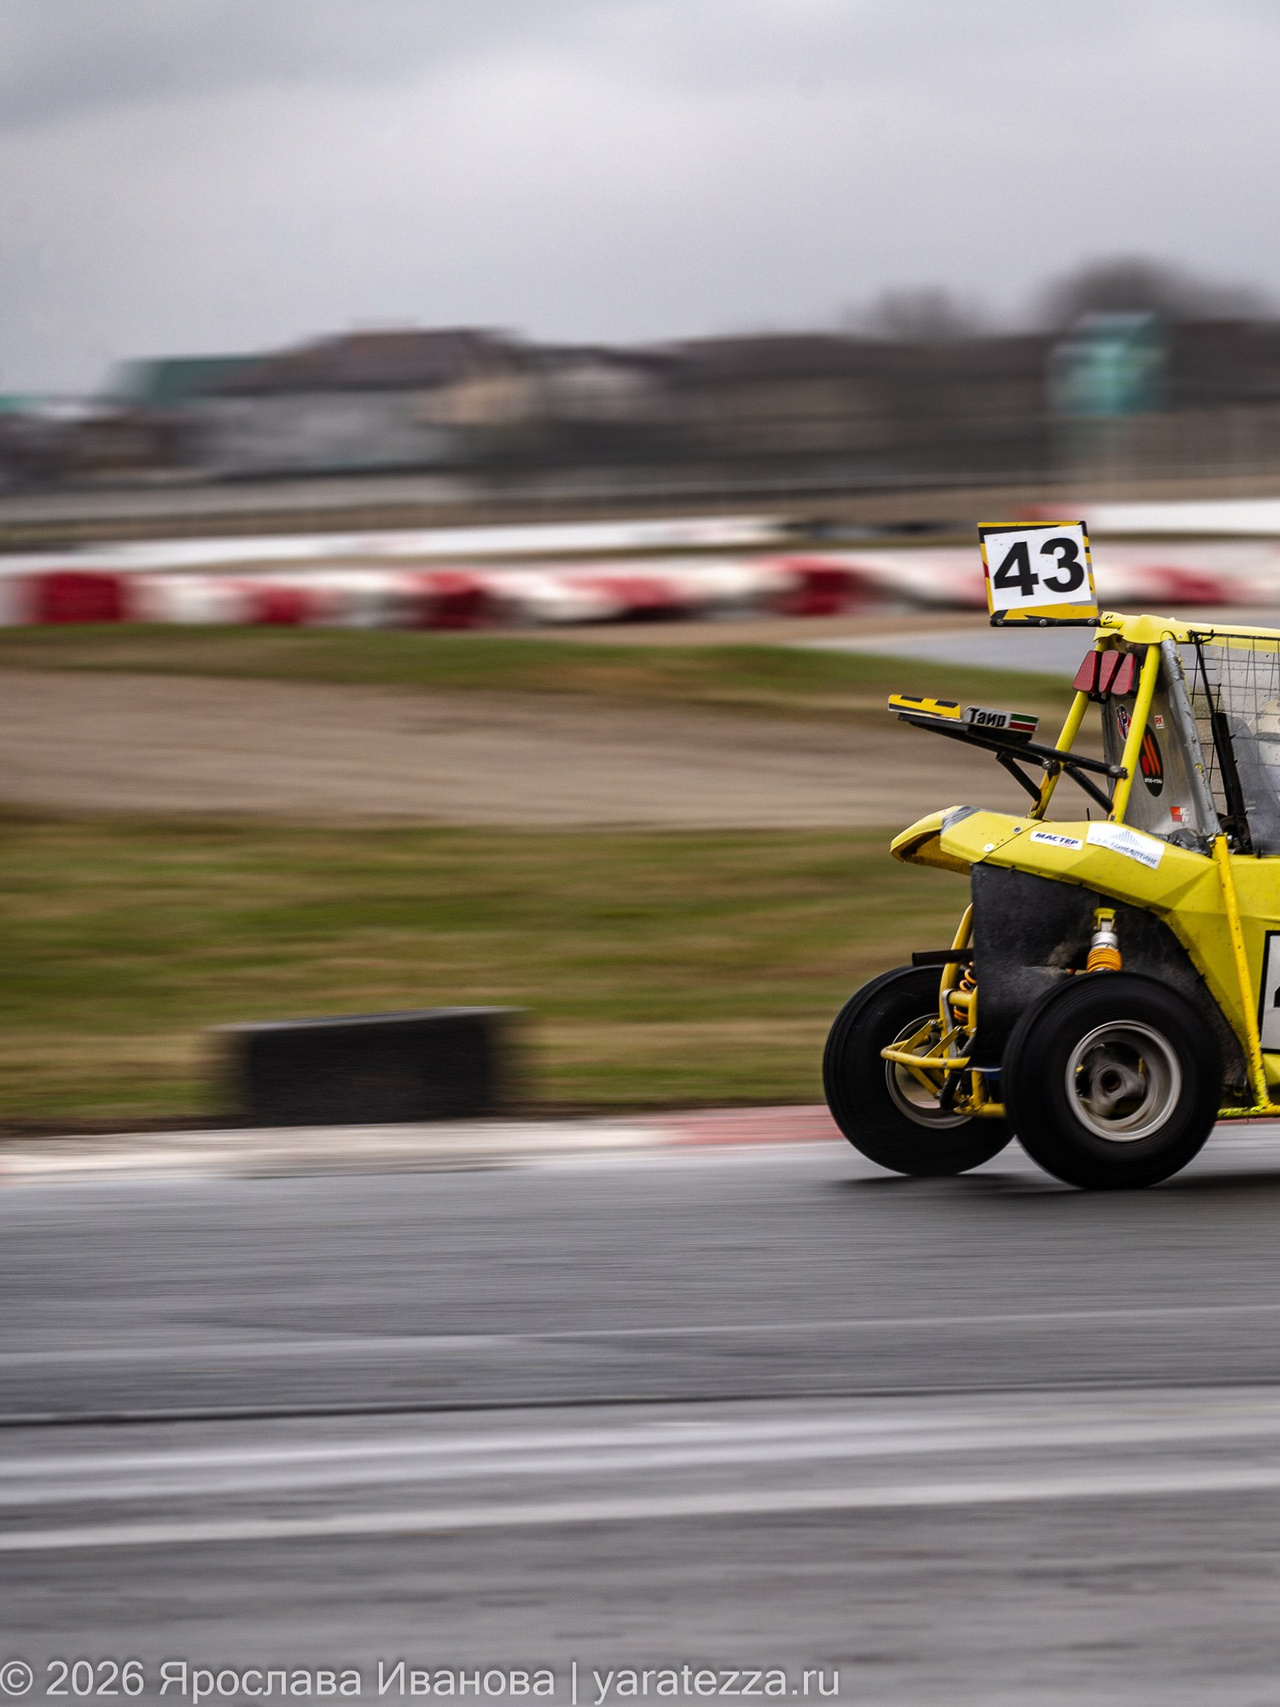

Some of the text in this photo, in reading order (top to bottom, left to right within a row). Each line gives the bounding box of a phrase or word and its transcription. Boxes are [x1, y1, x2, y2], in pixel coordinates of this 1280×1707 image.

[993, 537, 1085, 597] 43
[969, 708, 1006, 728] Таир
[1035, 832, 1079, 845] МАСТЕР
